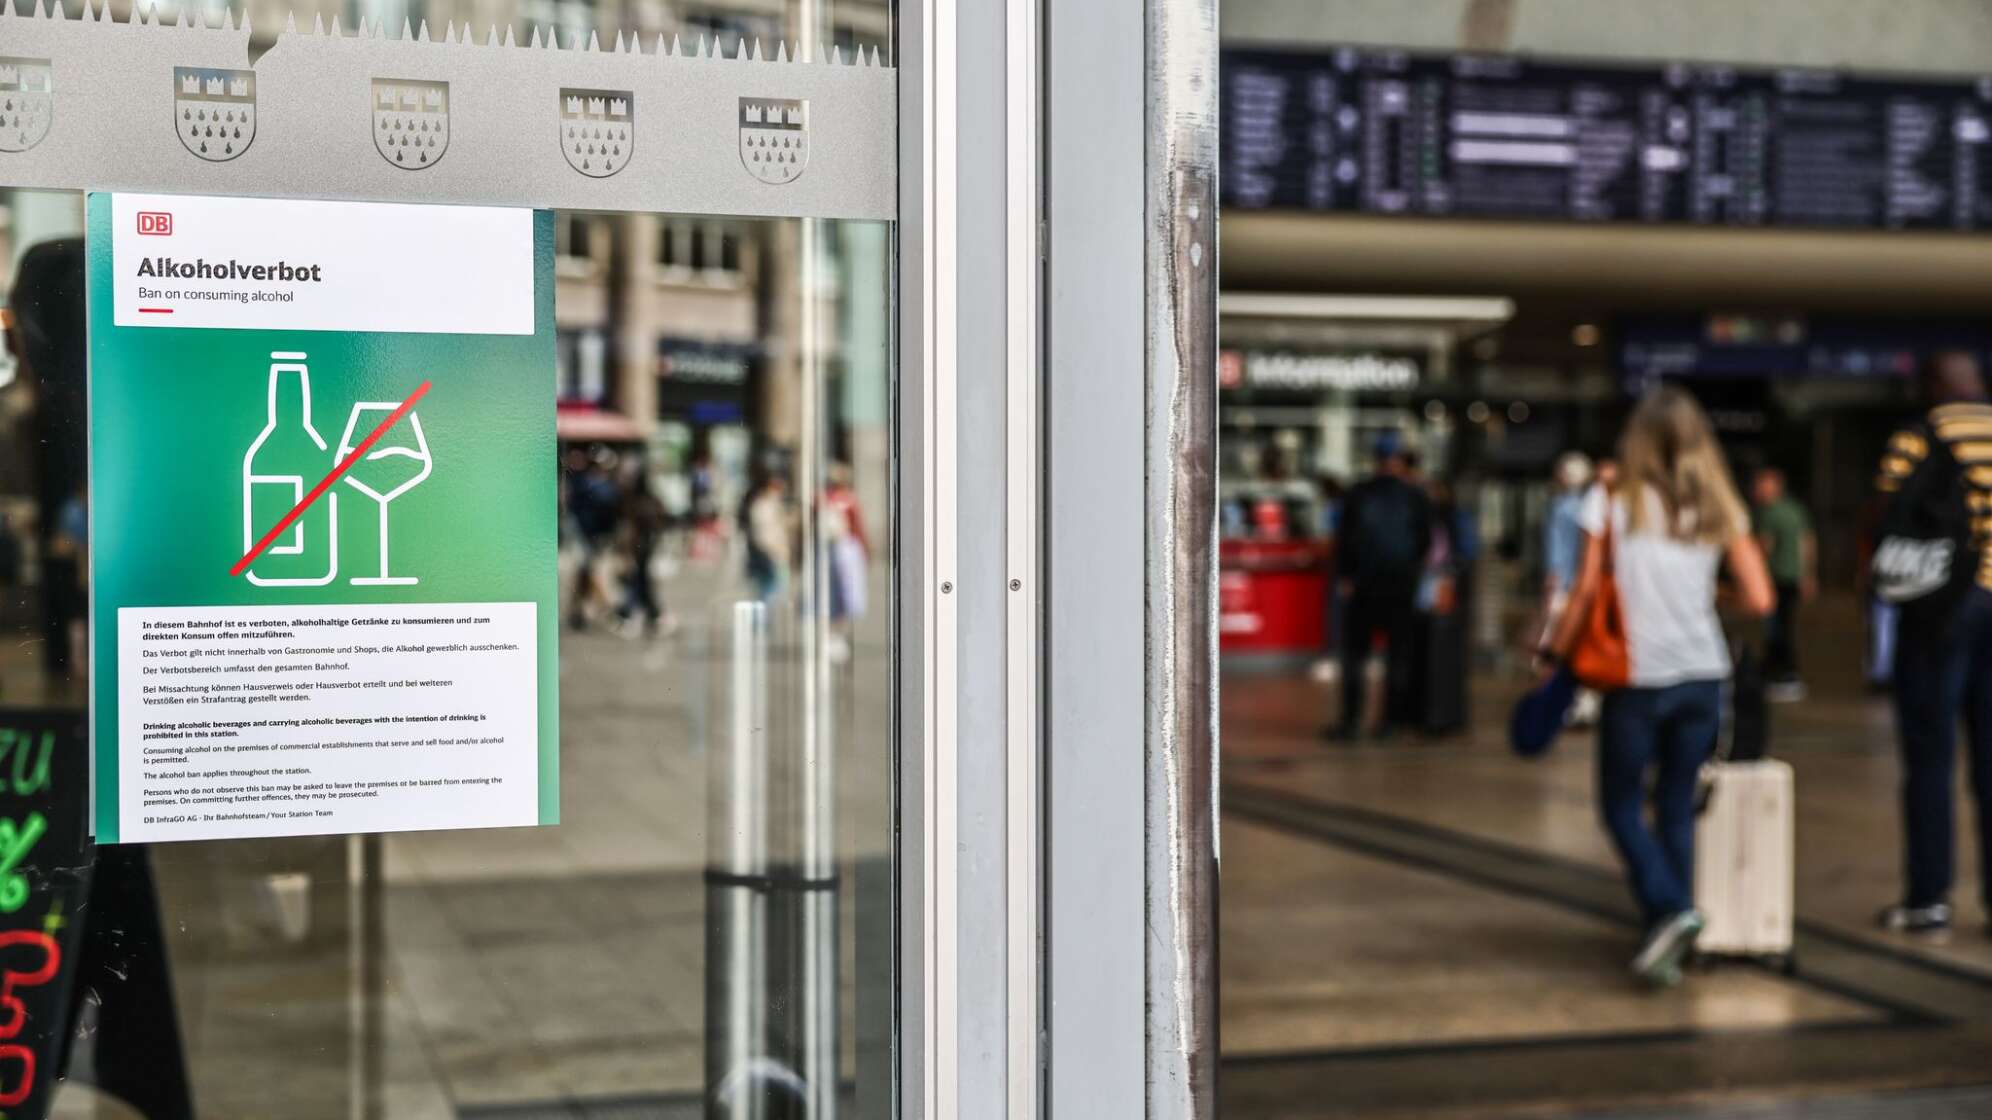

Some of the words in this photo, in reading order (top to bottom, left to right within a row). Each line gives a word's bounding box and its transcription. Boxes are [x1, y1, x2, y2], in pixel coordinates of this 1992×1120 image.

[139, 214, 170, 233] DB
[137, 257, 321, 283] Alkoholverbot
[138, 287, 162, 300] Ban
[165, 291, 181, 301] on
[184, 290, 249, 304] consuming
[251, 290, 294, 303] alcohol
[143, 621, 151, 629] In
[154, 620, 184, 629] diesem
[187, 619, 222, 628] Bahnhof
[224, 619, 235, 628] ist
[249, 619, 289, 628] verboten,
[291, 618, 349, 628] alkoholhaltige
[351, 617, 388, 626] Getränke
[402, 616, 454, 625] konsumieren
[456, 616, 471, 624] und
[143, 632, 178, 640] direkten
[181, 632, 214, 640] Konsum
[217, 631, 239, 639] offen
[241, 630, 294, 639] mitzuführen.
[142, 649, 158, 657] Das
[159, 649, 187, 657] Verbot
[189, 648, 202, 659] gilt
[205, 648, 225, 656] nicht
[227, 647, 266, 656] innerhalb
[284, 646, 335, 655] Gastronomie
[337, 645, 352, 654] und
[353, 645, 379, 655] Shops,
[381, 645, 393, 653] die
[395, 644, 424, 653] Alkohol
[426, 643, 467, 654] gewerblich
[469, 642, 519, 651] ausschenken.
[143, 666, 157, 674] Der
[160, 665, 221, 674] Verbotsbereich
[224, 664, 255, 673] umfasst
[257, 664, 272, 672] den
[274, 664, 312, 674] gesamten
[315, 662, 349, 671] Bahnhof.
[143, 685, 156, 693] Bei
[158, 684, 209, 694] Missachtung
[210, 683, 240, 692] können
[243, 682, 293, 691] Hausverweis
[295, 681, 314, 690] oder
[316, 680, 360, 689] Hausverbot
[362, 680, 386, 688] erteilt
[388, 679, 403, 688] und
[405, 679, 417, 687] bei
[419, 679, 452, 687] weiteren
[142, 696, 184, 705] Verstößen
[186, 696, 198, 704] ein
[201, 695, 246, 705] Strafantrag
[248, 694, 277, 705] gestellt
[279, 693, 311, 702] werden.
[143, 721, 176, 732] Drinking
[177, 720, 211, 729] alcoholic
[213, 720, 251, 730] beverages
[253, 719, 267, 727] and
[268, 718, 300, 729] carrying
[301, 717, 333, 726] alcoholic
[335, 717, 372, 727] beverages
[374, 715, 390, 724] with
[391, 715, 404, 723] the
[405, 714, 438, 723] intention
[439, 714, 447, 722] of
[448, 713, 478, 723] drinking
[480, 712, 485, 721] is
[143, 730, 183, 742] prohibited
[185, 730, 192, 738] in
[194, 730, 208, 738] this
[210, 729, 239, 738] station.
[143, 746, 183, 756] Consuming
[184, 745, 210, 754] alcohol
[223, 744, 235, 752] the
[237, 743, 269, 754] premises
[270, 743, 278, 751] of
[279, 741, 320, 751] commercial
[321, 740, 373, 749] establishments
[375, 739, 388, 748] that
[411, 738, 423, 746] and
[425, 738, 437, 746] sell
[438, 737, 454, 746] food
[455, 737, 478, 746] and/or
[480, 735, 504, 744] alcohol
[143, 756, 149, 765] is
[151, 755, 189, 767] permitted.
[143, 771, 157, 780] The
[159, 770, 185, 779] alcohol
[186, 770, 200, 778] ban
[202, 769, 228, 780] applies
[229, 768, 269, 778] throughout
[271, 767, 283, 775] the
[285, 766, 311, 775] station.
[143, 788, 172, 796] Persons
[173, 787, 189, 795] who
[190, 786, 200, 795] do
[215, 785, 244, 794] observe
[246, 784, 259, 793] this
[261, 784, 274, 792] ban
[276, 785, 291, 793] may
[292, 783, 301, 791] be
[303, 782, 323, 790] asked
[325, 782, 332, 790] to
[334, 781, 352, 789] leave
[354, 780, 365, 789] the
[367, 779, 398, 790] premises
[409, 778, 417, 787] be
[419, 777, 442, 786] barred
[443, 777, 460, 785] from
[461, 776, 489, 786] entering
[491, 775, 502, 784] the
[143, 797, 178, 808] premises.
[179, 796, 190, 805] On
[192, 795, 233, 805] committing
[234, 794, 260, 802] further
[261, 793, 293, 802] offences,
[294, 792, 310, 802] they
[311, 793, 326, 801] may
[328, 791, 337, 799] be
[338, 789, 379, 801] prosecuted.
[143, 815, 154, 824] DB
[156, 814, 185, 823] InfraGO
[186, 813, 197, 822] AG
[203, 813, 213, 821] Ihr
[216, 810, 286, 821] Bahnhofsteam/Your
[288, 809, 312, 818] Station
[315, 809, 333, 817] Team
